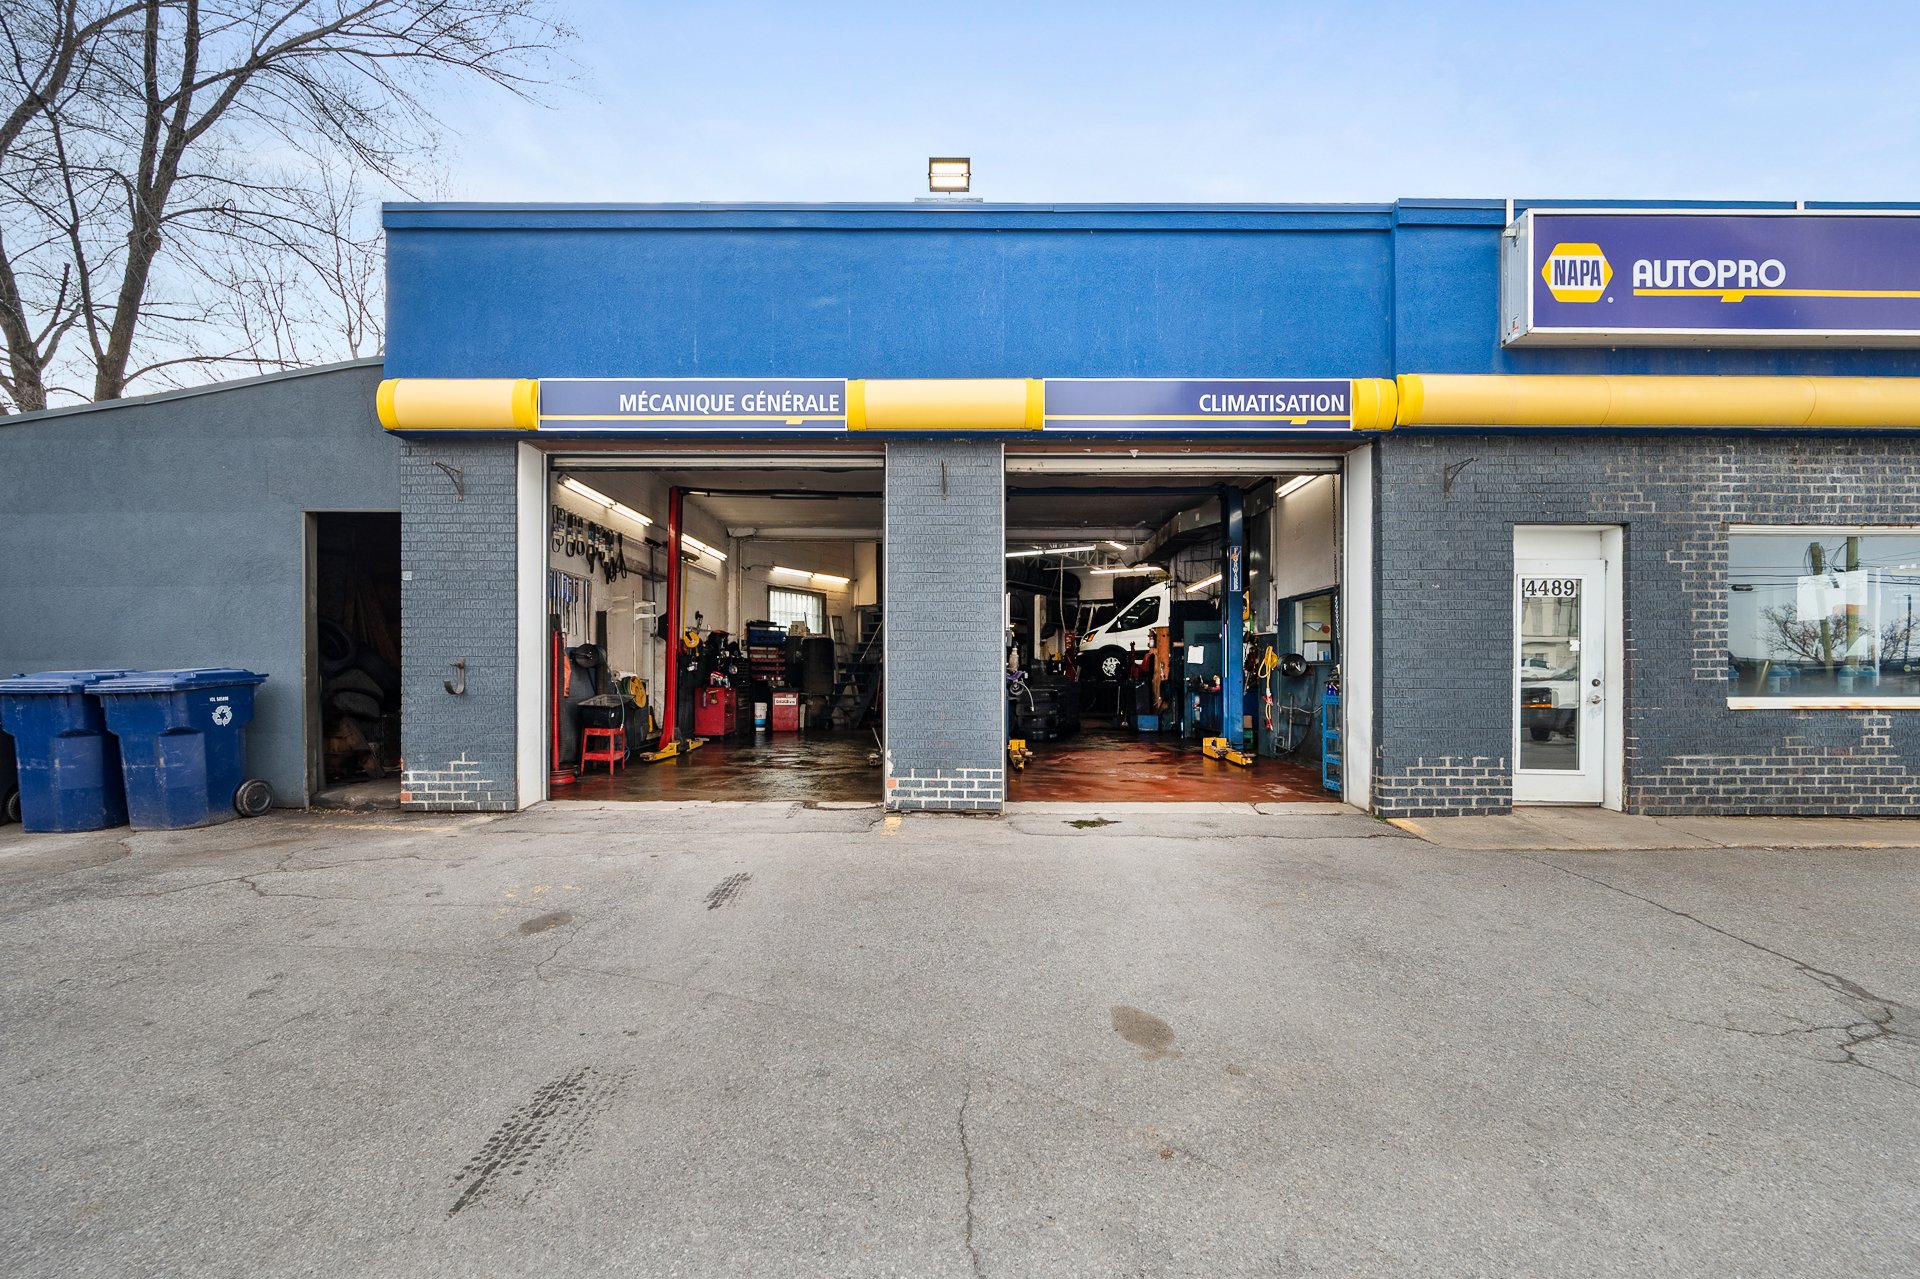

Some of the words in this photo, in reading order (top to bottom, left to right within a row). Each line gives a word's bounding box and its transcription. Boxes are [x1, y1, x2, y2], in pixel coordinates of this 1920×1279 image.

[1554, 259, 1602, 287] NAPA
[1633, 259, 1787, 288] AUTOPRO
[619, 390, 735, 415] MÉCANIQUE
[741, 390, 840, 413] GÉNÉRALE
[1199, 394, 1344, 412] CLIMATISATION
[1526, 580, 1574, 596] 4489
